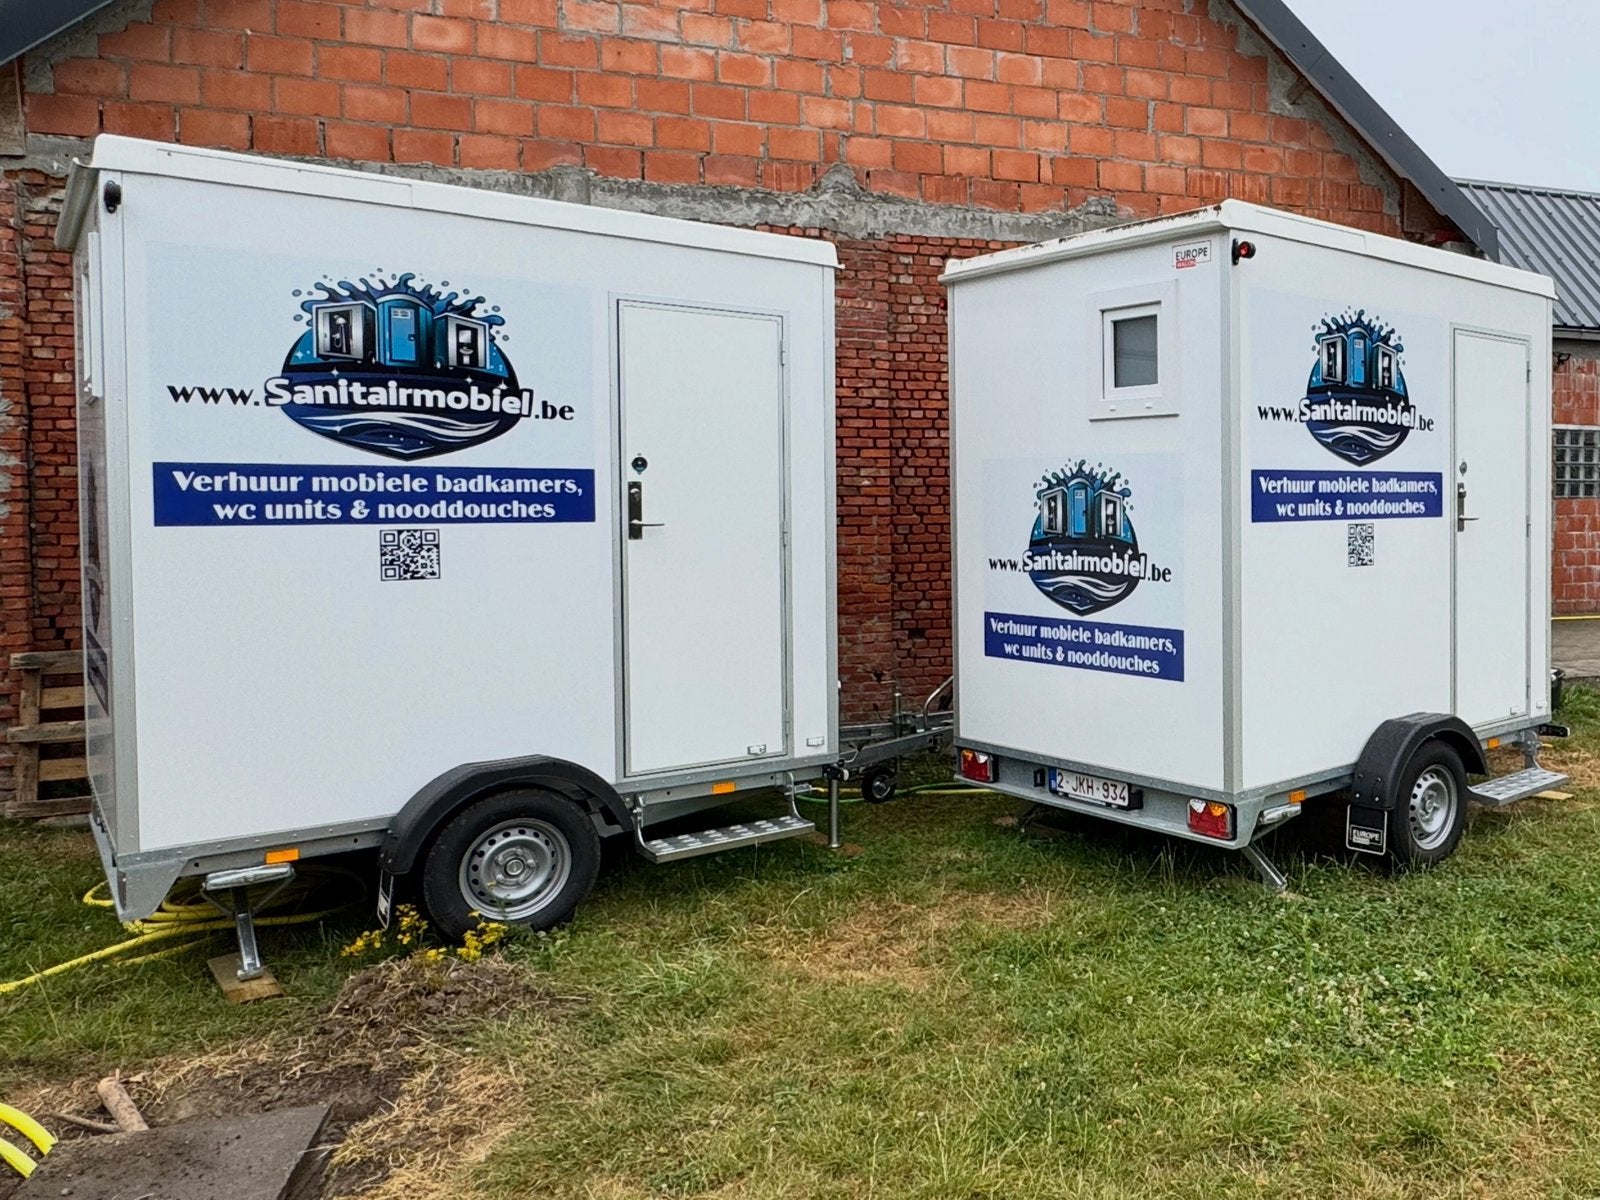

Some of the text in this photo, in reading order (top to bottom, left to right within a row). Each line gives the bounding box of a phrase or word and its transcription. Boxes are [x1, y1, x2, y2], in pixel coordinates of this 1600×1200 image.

[1175, 247, 1208, 261] EUROPE
[166, 377, 575, 421] www.Sanitairmobiel.be
[1257, 398, 1434, 432] www.Sanitairmobiel.be
[172, 470, 583, 496] Verhuur mobiele badkamers,
[1259, 476, 1437, 495] Verhuur mobiele badkamers,
[213, 498, 556, 520] wc units & nooddouches
[1276, 499, 1425, 517] wc units & nooddouches
[988, 549, 1172, 583] www.Sanitairmobiel.be
[990, 617, 1177, 655] Verhuur mobiele badkamers,
[1003, 642, 1160, 674] wc units & nooddouches
[1352, 829, 1380, 842] EUROPE
